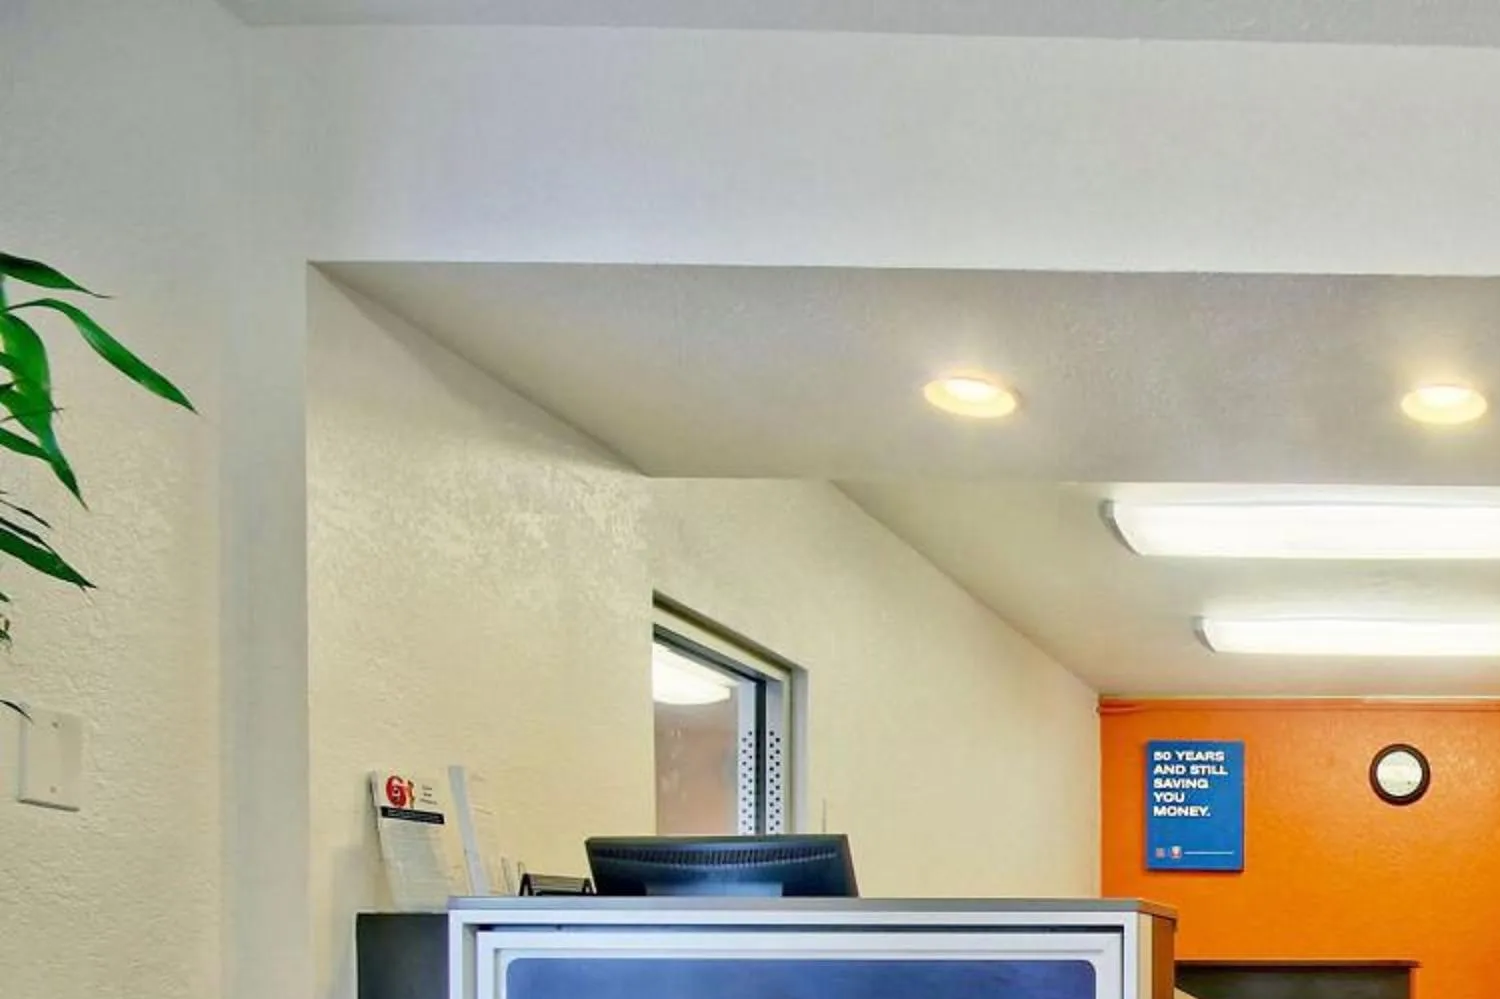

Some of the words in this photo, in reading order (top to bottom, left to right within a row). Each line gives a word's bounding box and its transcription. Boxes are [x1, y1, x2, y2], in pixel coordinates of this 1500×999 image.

[1153, 751, 1172, 762] 50
[1175, 751, 1225, 762] YEARS
[1153, 764, 1186, 775] AND
[1189, 765, 1228, 775] STILL
[1153, 778, 1209, 790] SAVING
[1153, 792, 1185, 803] YOU
[1153, 805, 1211, 817] MONEY.
